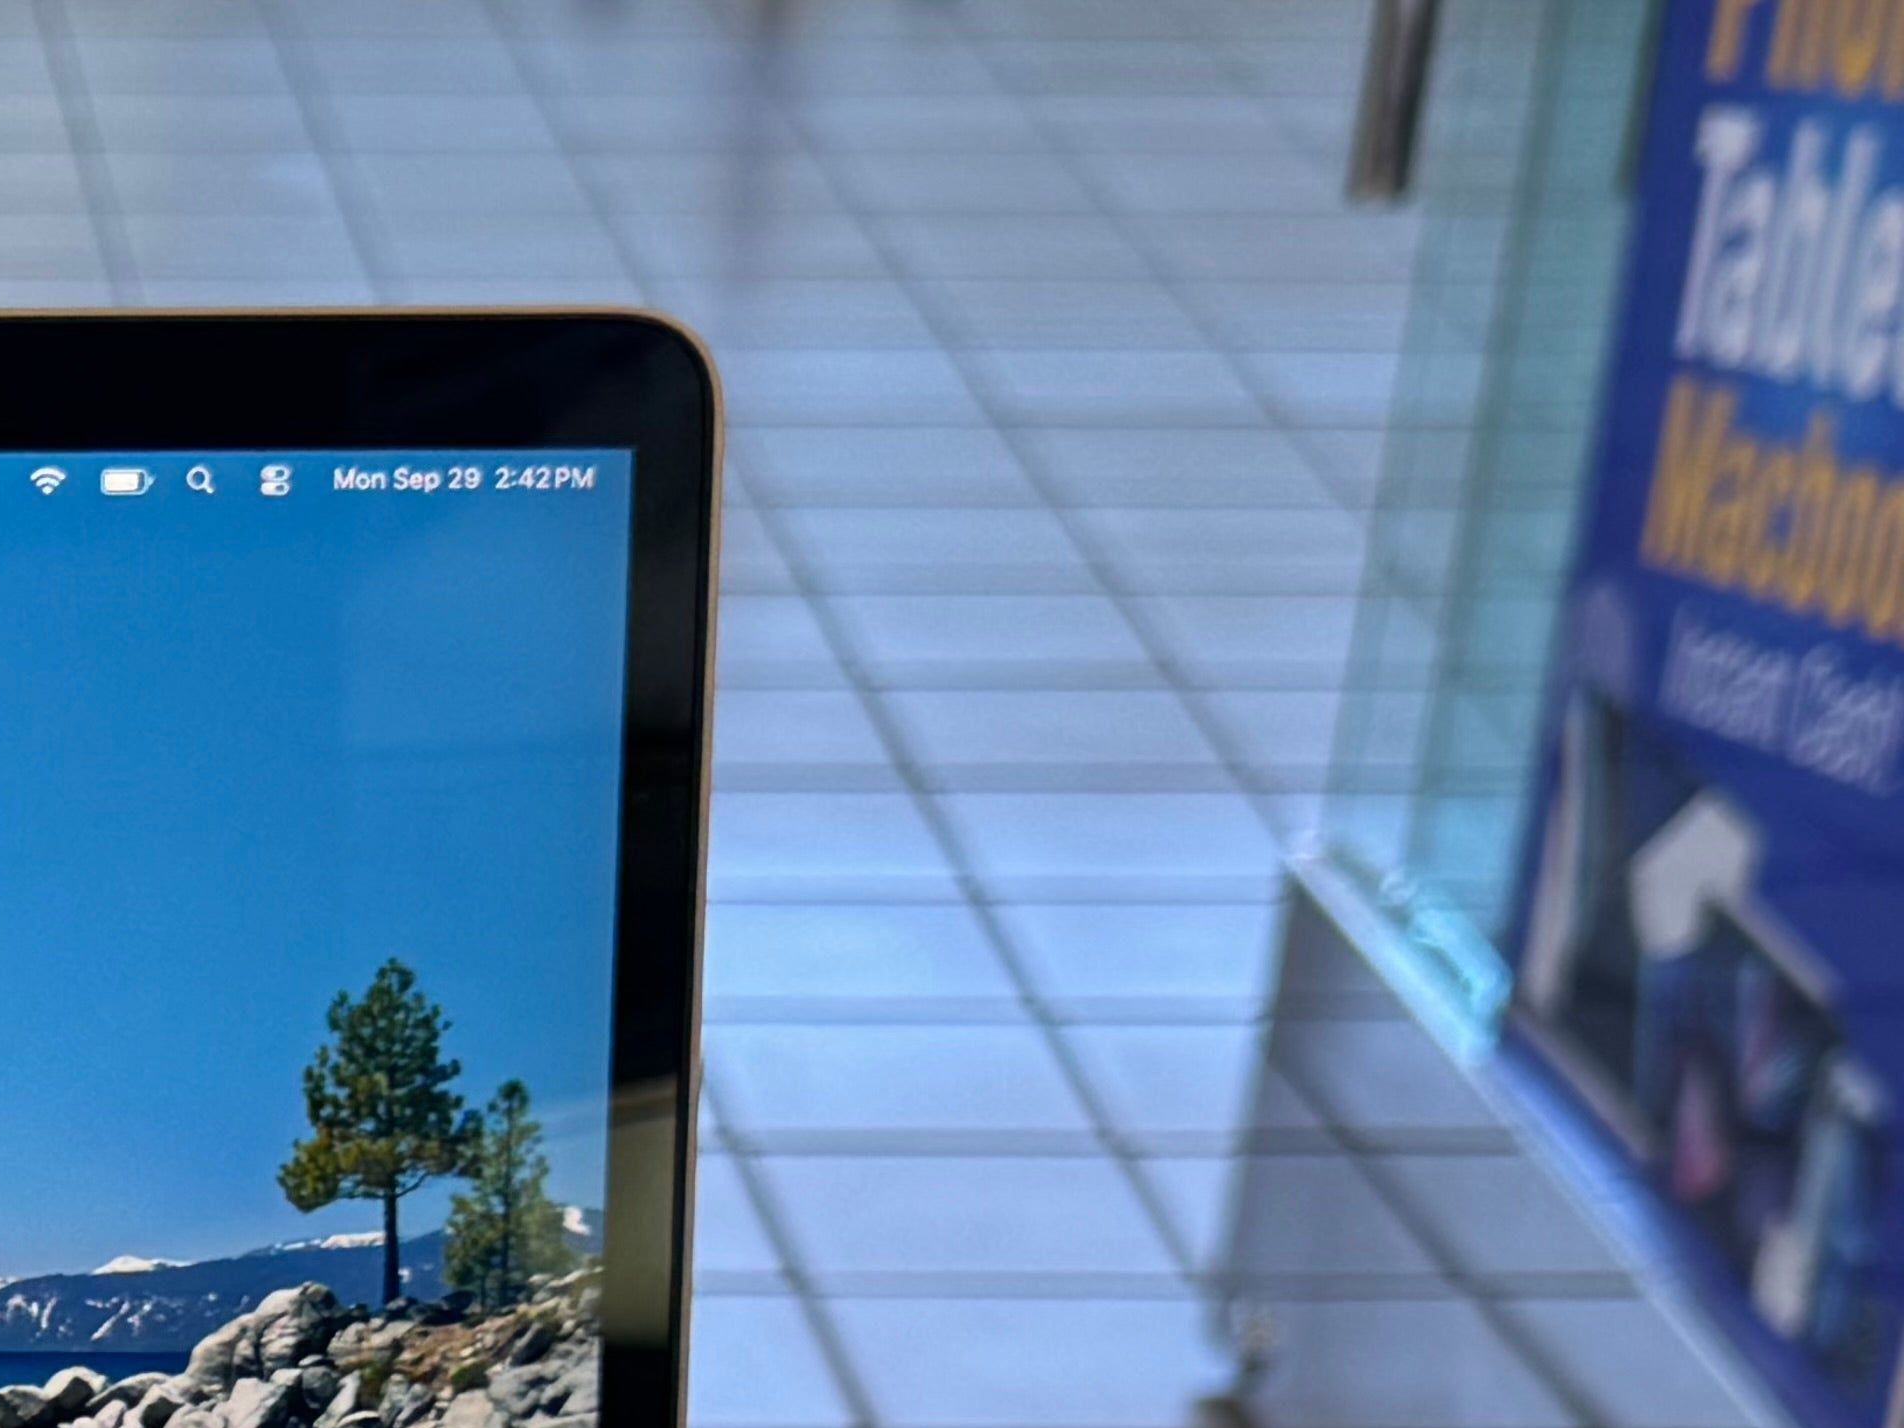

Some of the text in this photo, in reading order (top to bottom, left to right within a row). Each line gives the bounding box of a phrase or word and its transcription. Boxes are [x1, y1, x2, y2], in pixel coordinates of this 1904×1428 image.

[334, 468, 386, 490] Mon
[393, 467, 441, 493] Sep
[448, 467, 481, 489] 29
